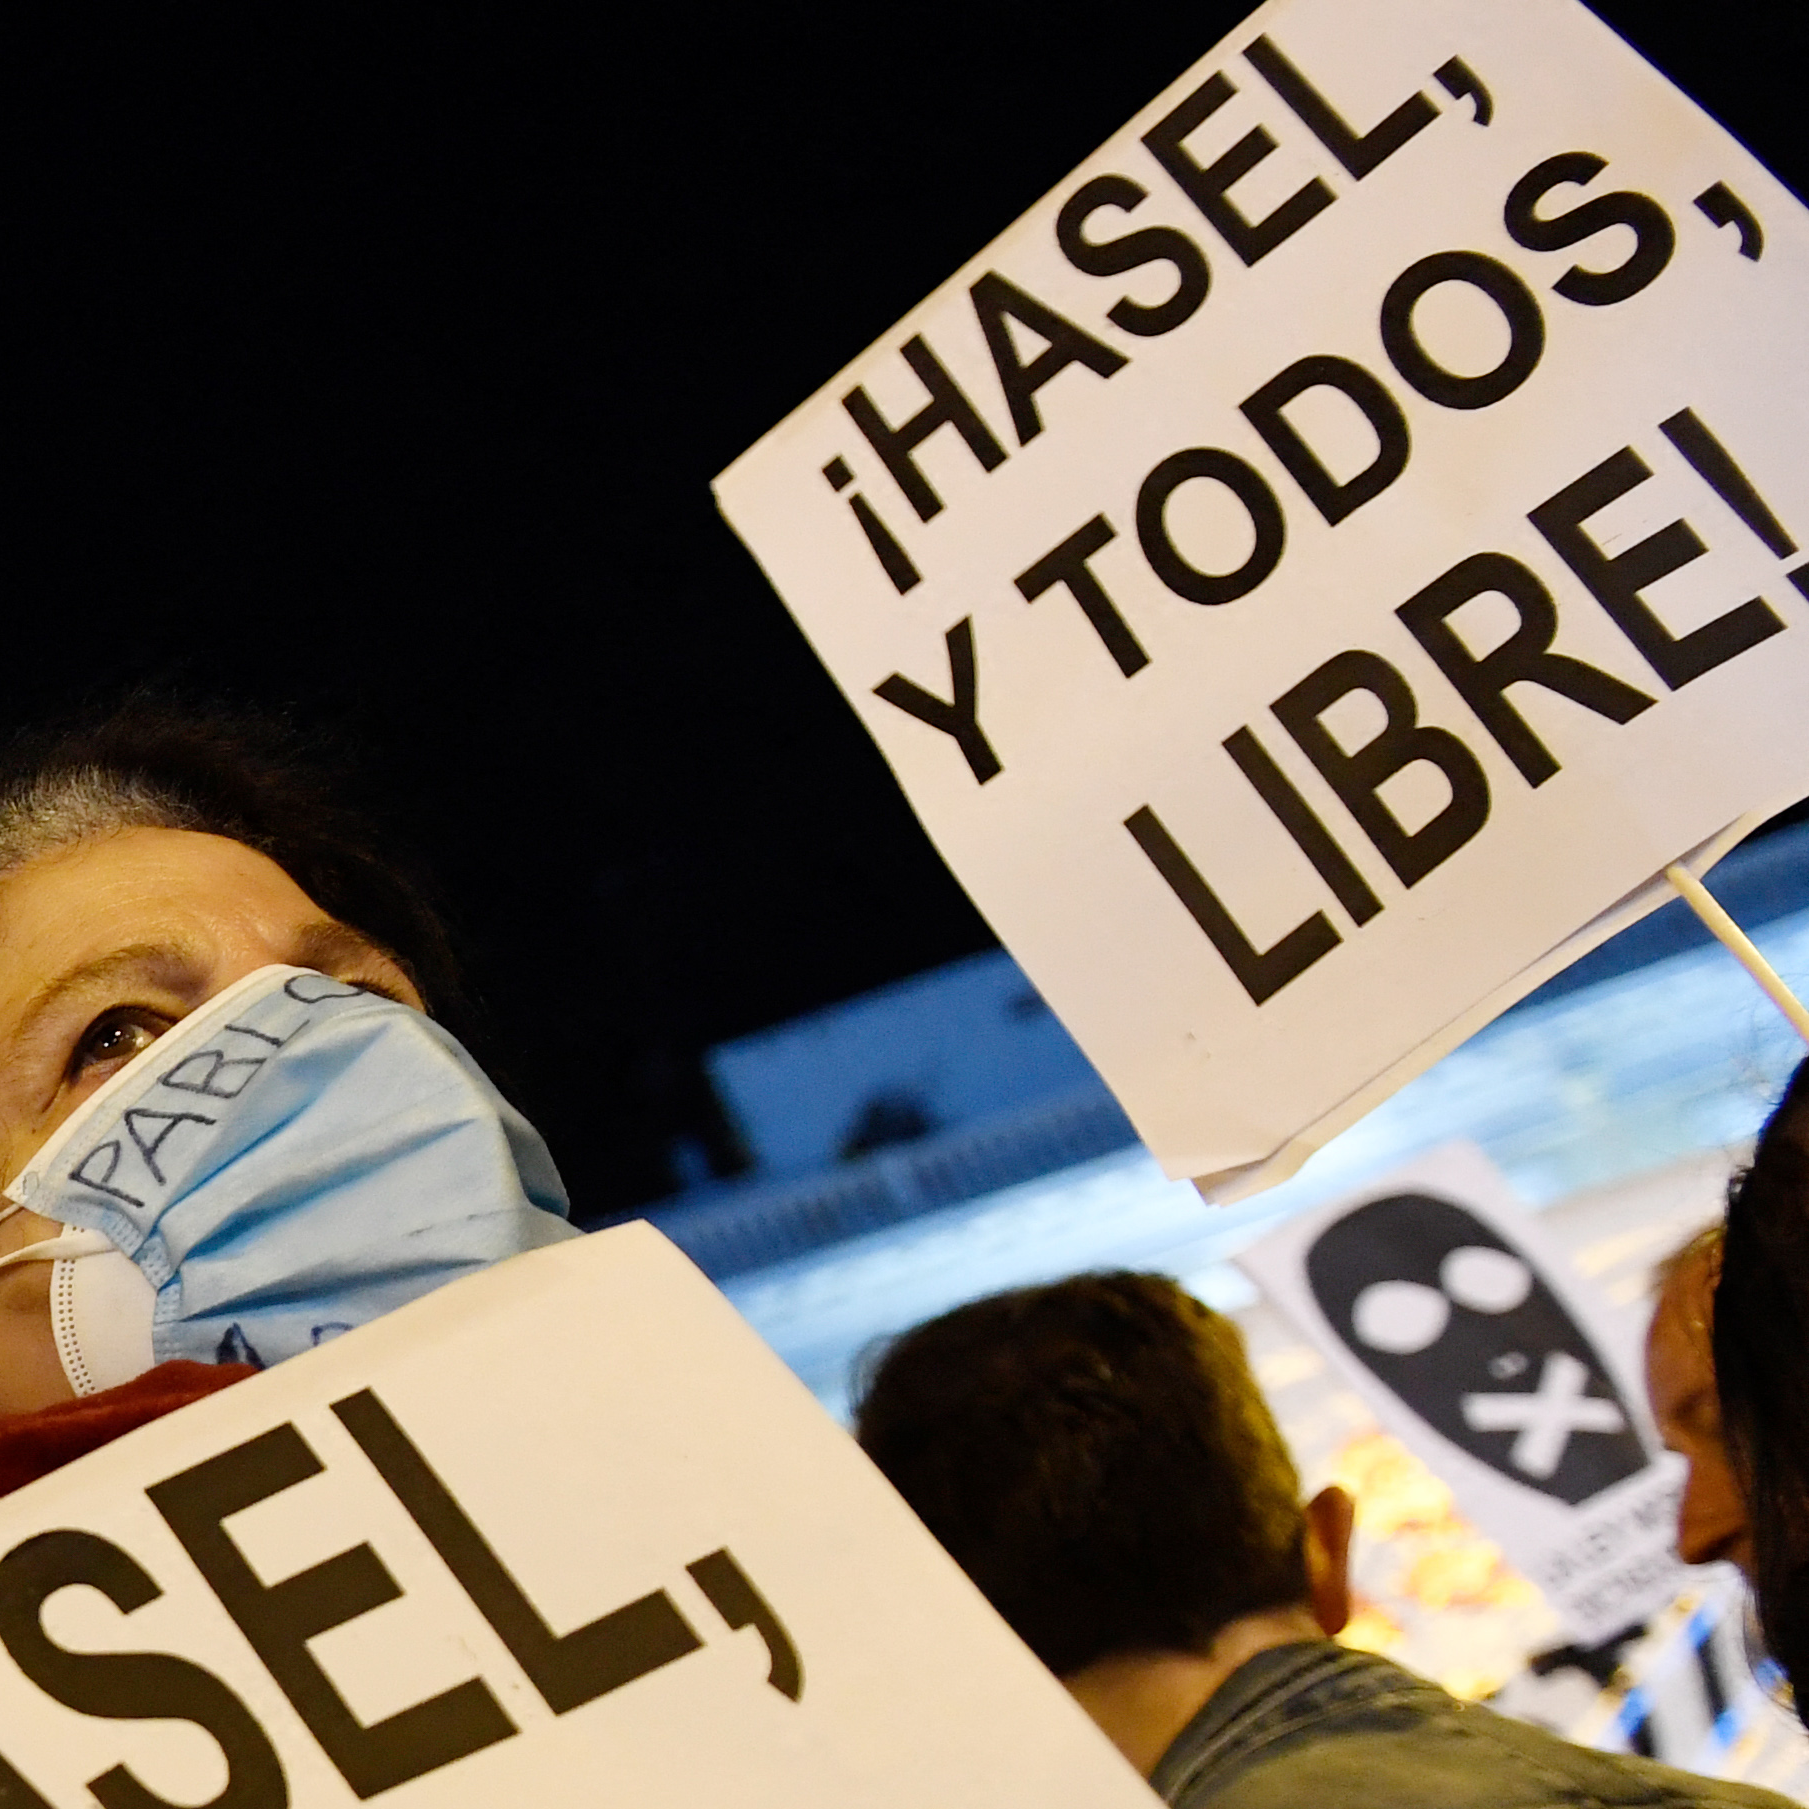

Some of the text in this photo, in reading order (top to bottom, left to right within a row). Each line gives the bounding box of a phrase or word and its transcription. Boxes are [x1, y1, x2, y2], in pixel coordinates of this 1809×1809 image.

[821, 31, 1495, 597] ¡HASEL,
[872, 148, 1765, 788] Y TODOS,
[1121, 405, 1809, 1008] LIBRE!
